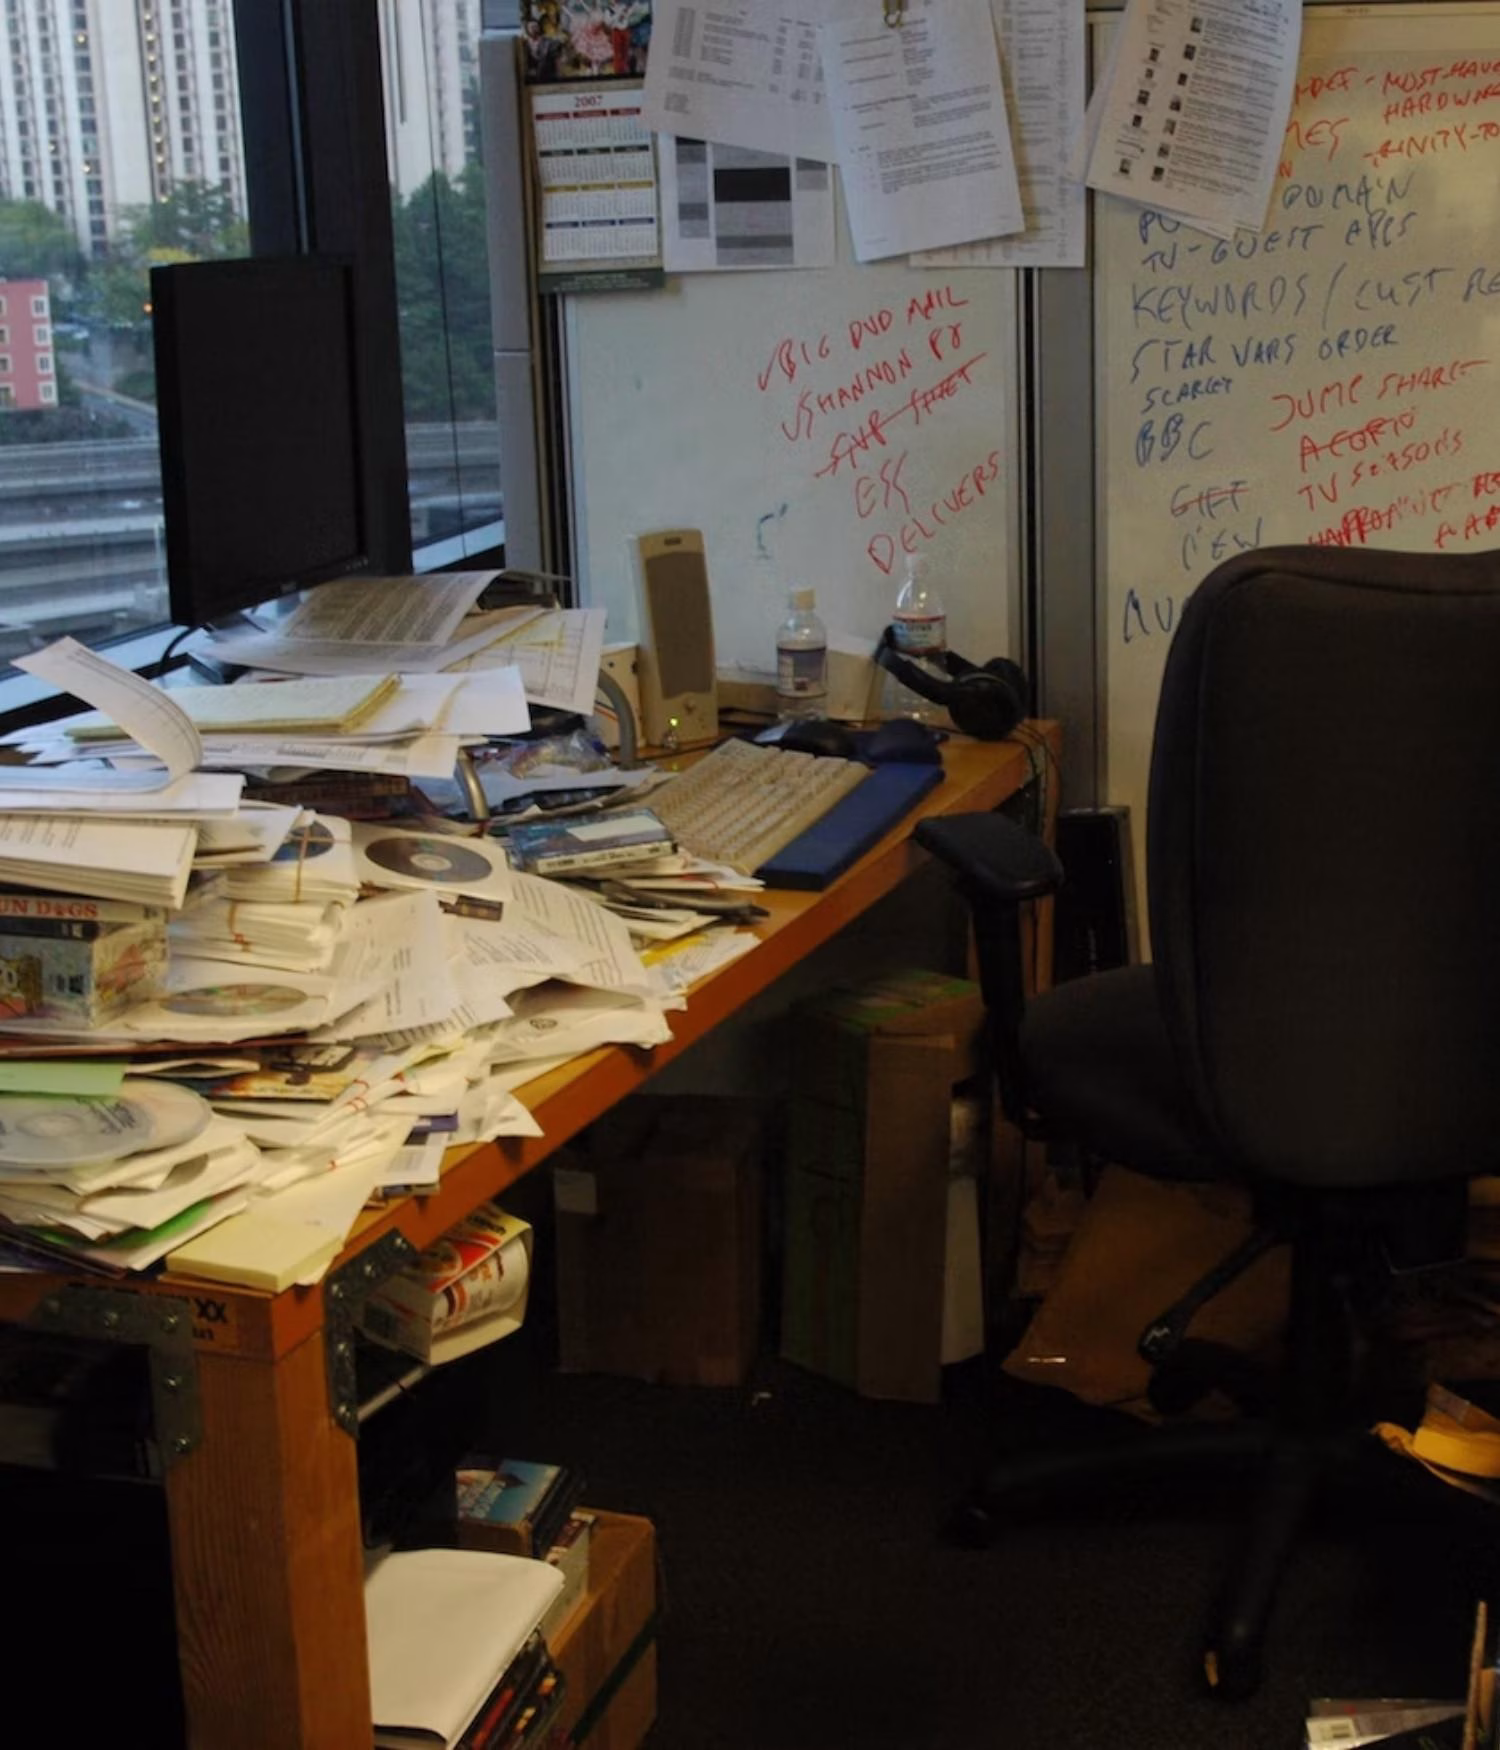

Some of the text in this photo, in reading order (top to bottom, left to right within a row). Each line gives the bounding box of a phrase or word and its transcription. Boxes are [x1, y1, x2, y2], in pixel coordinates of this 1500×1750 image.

[573, 95, 603, 108] 2007
[1132, 272, 1308, 329] KEYWORDS
[849, 309, 893, 350] DVD
[1130, 335, 1217, 383] STAR
[1318, 324, 1400, 361] ORDER
[1135, 411, 1214, 468] BBC
